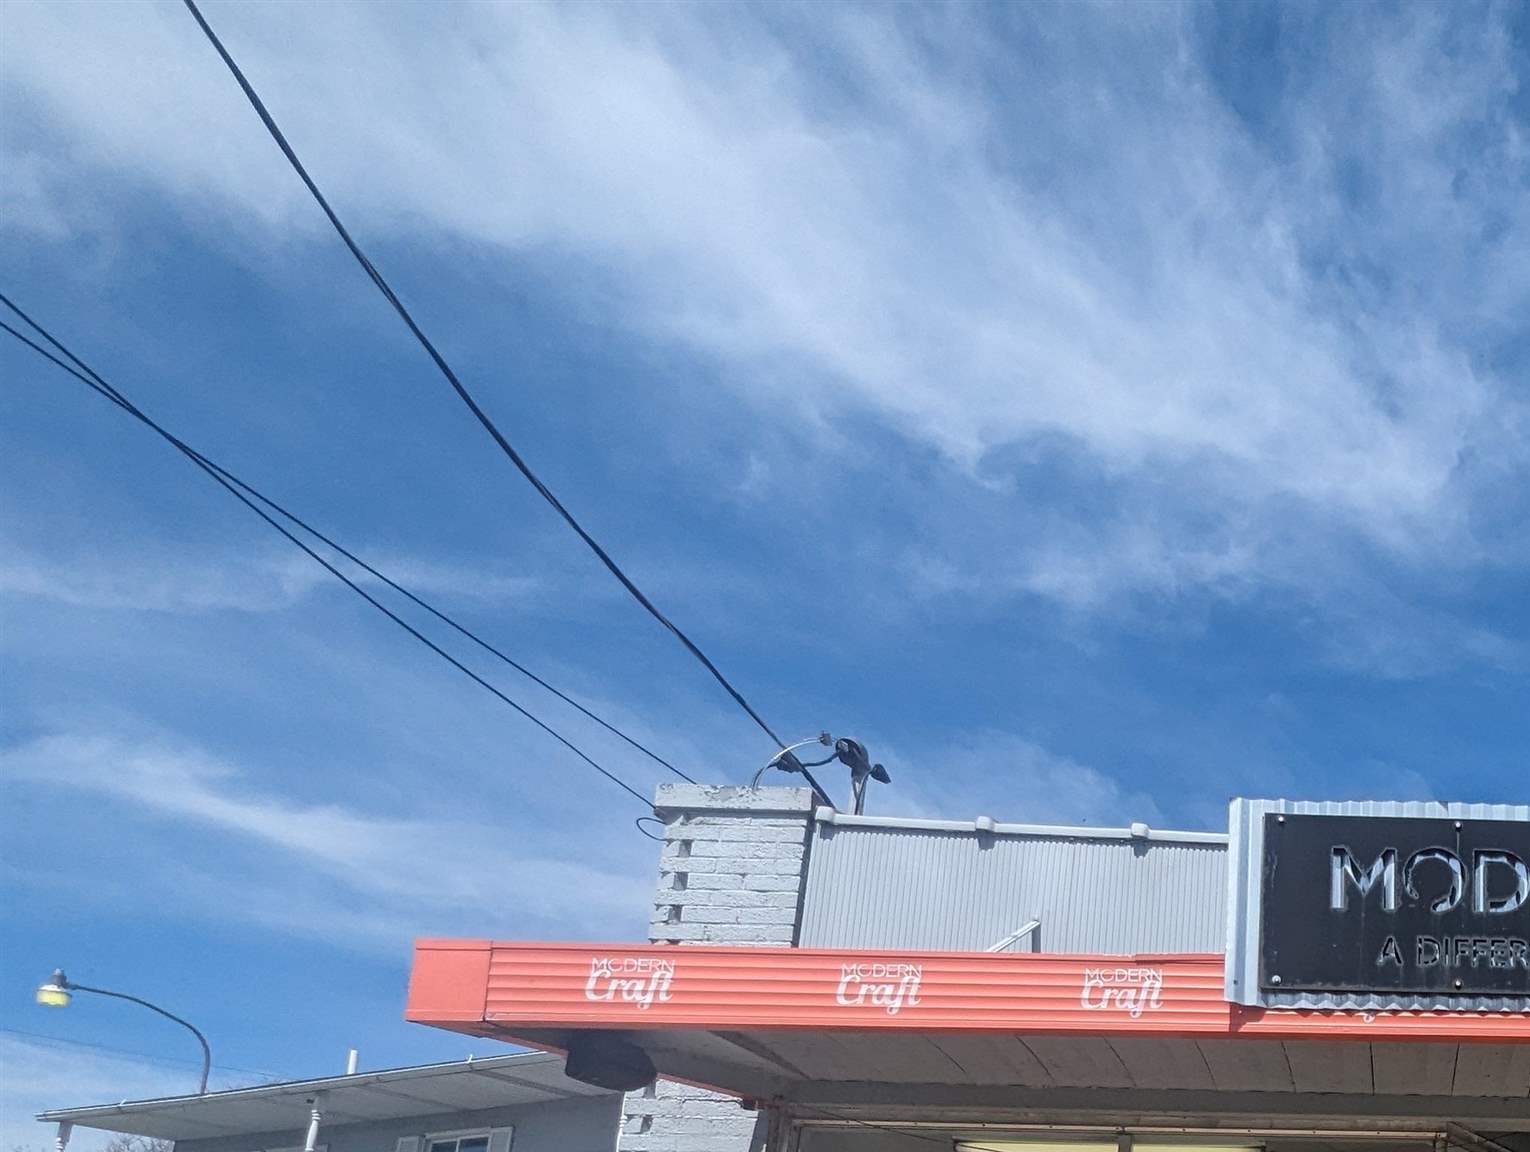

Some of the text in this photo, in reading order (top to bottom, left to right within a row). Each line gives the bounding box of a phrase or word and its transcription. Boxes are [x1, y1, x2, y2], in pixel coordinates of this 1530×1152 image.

[591, 957, 675, 974] MODERN
[1376, 936, 1403, 966] A
[841, 963, 922, 979] MODERN
[1085, 968, 1162, 984] MODERN
[585, 969, 674, 1010] Craft
[836, 975, 921, 1015] Craft
[1081, 980, 1164, 1018] Craft
